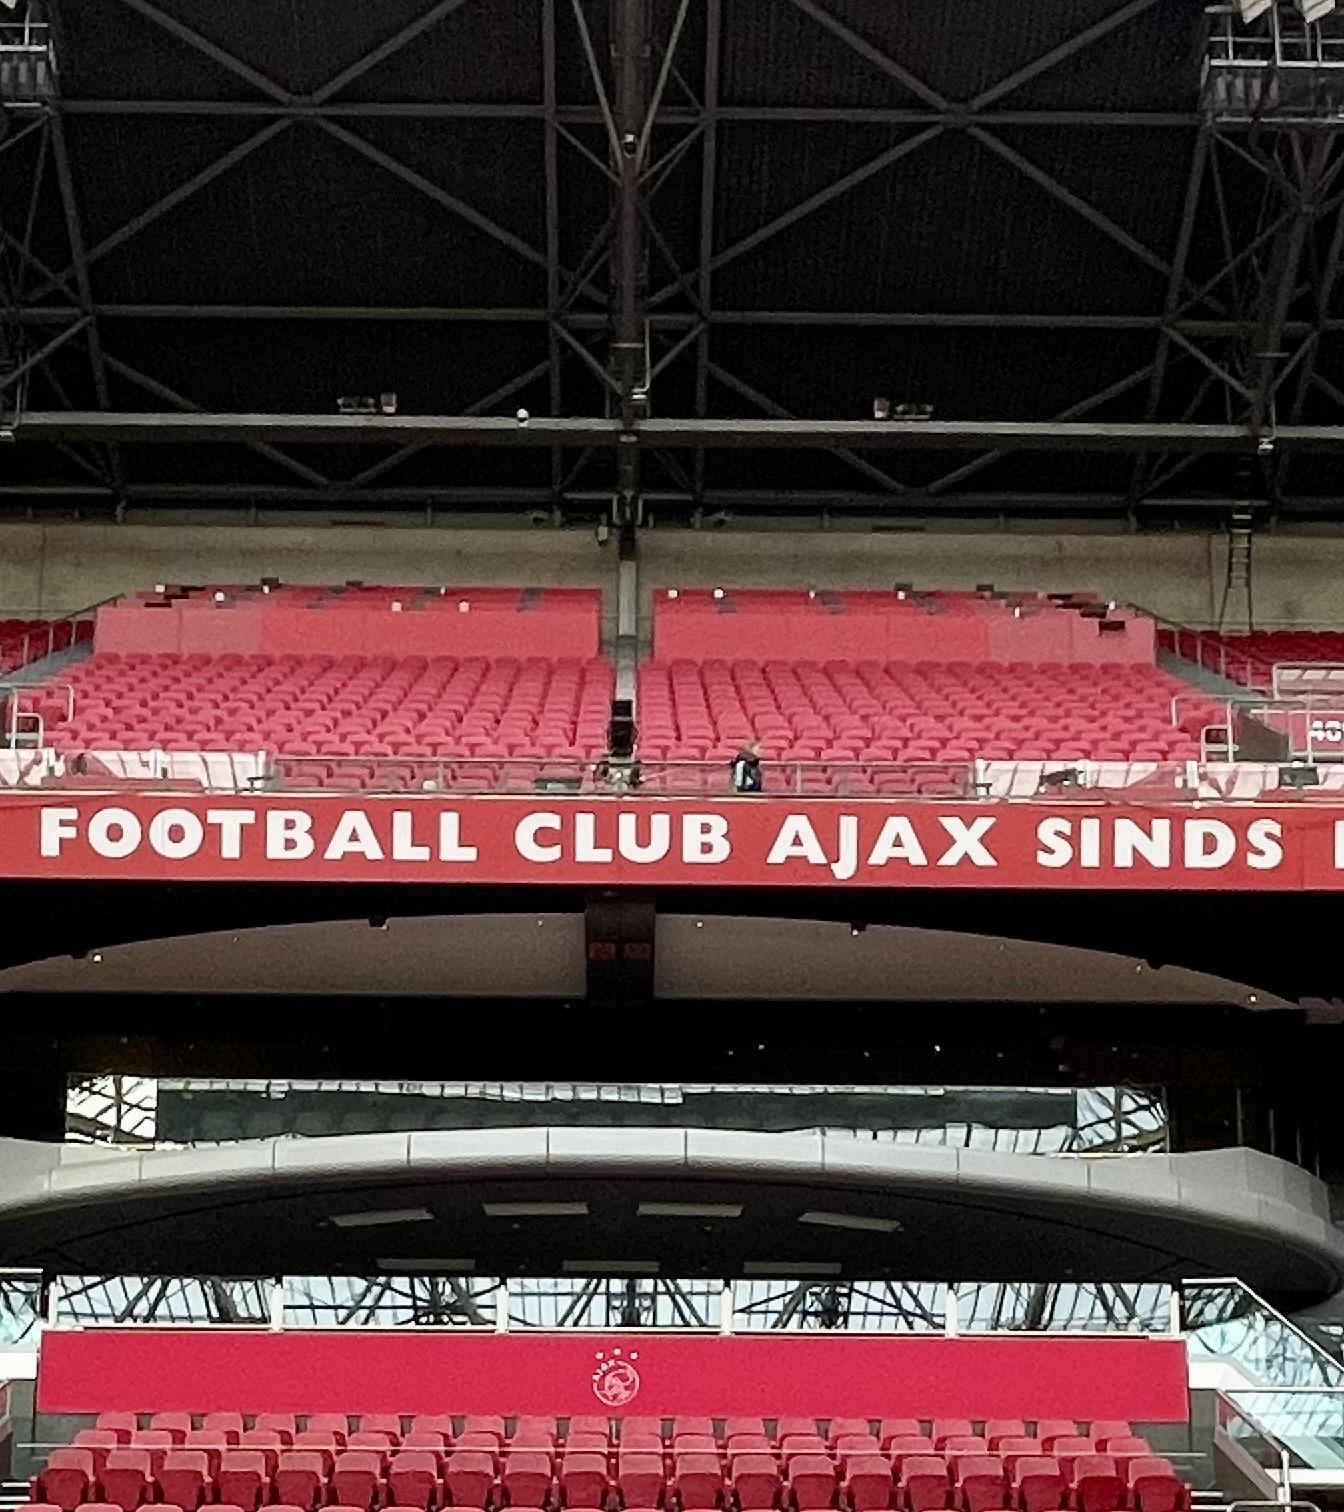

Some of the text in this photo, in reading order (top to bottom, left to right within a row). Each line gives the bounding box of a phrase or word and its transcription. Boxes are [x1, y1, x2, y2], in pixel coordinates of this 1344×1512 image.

[40, 808, 477, 861] FOOTBALL
[515, 812, 730, 866] CLUB
[766, 814, 998, 880] AJAX
[1036, 817, 1282, 869] SINDS
